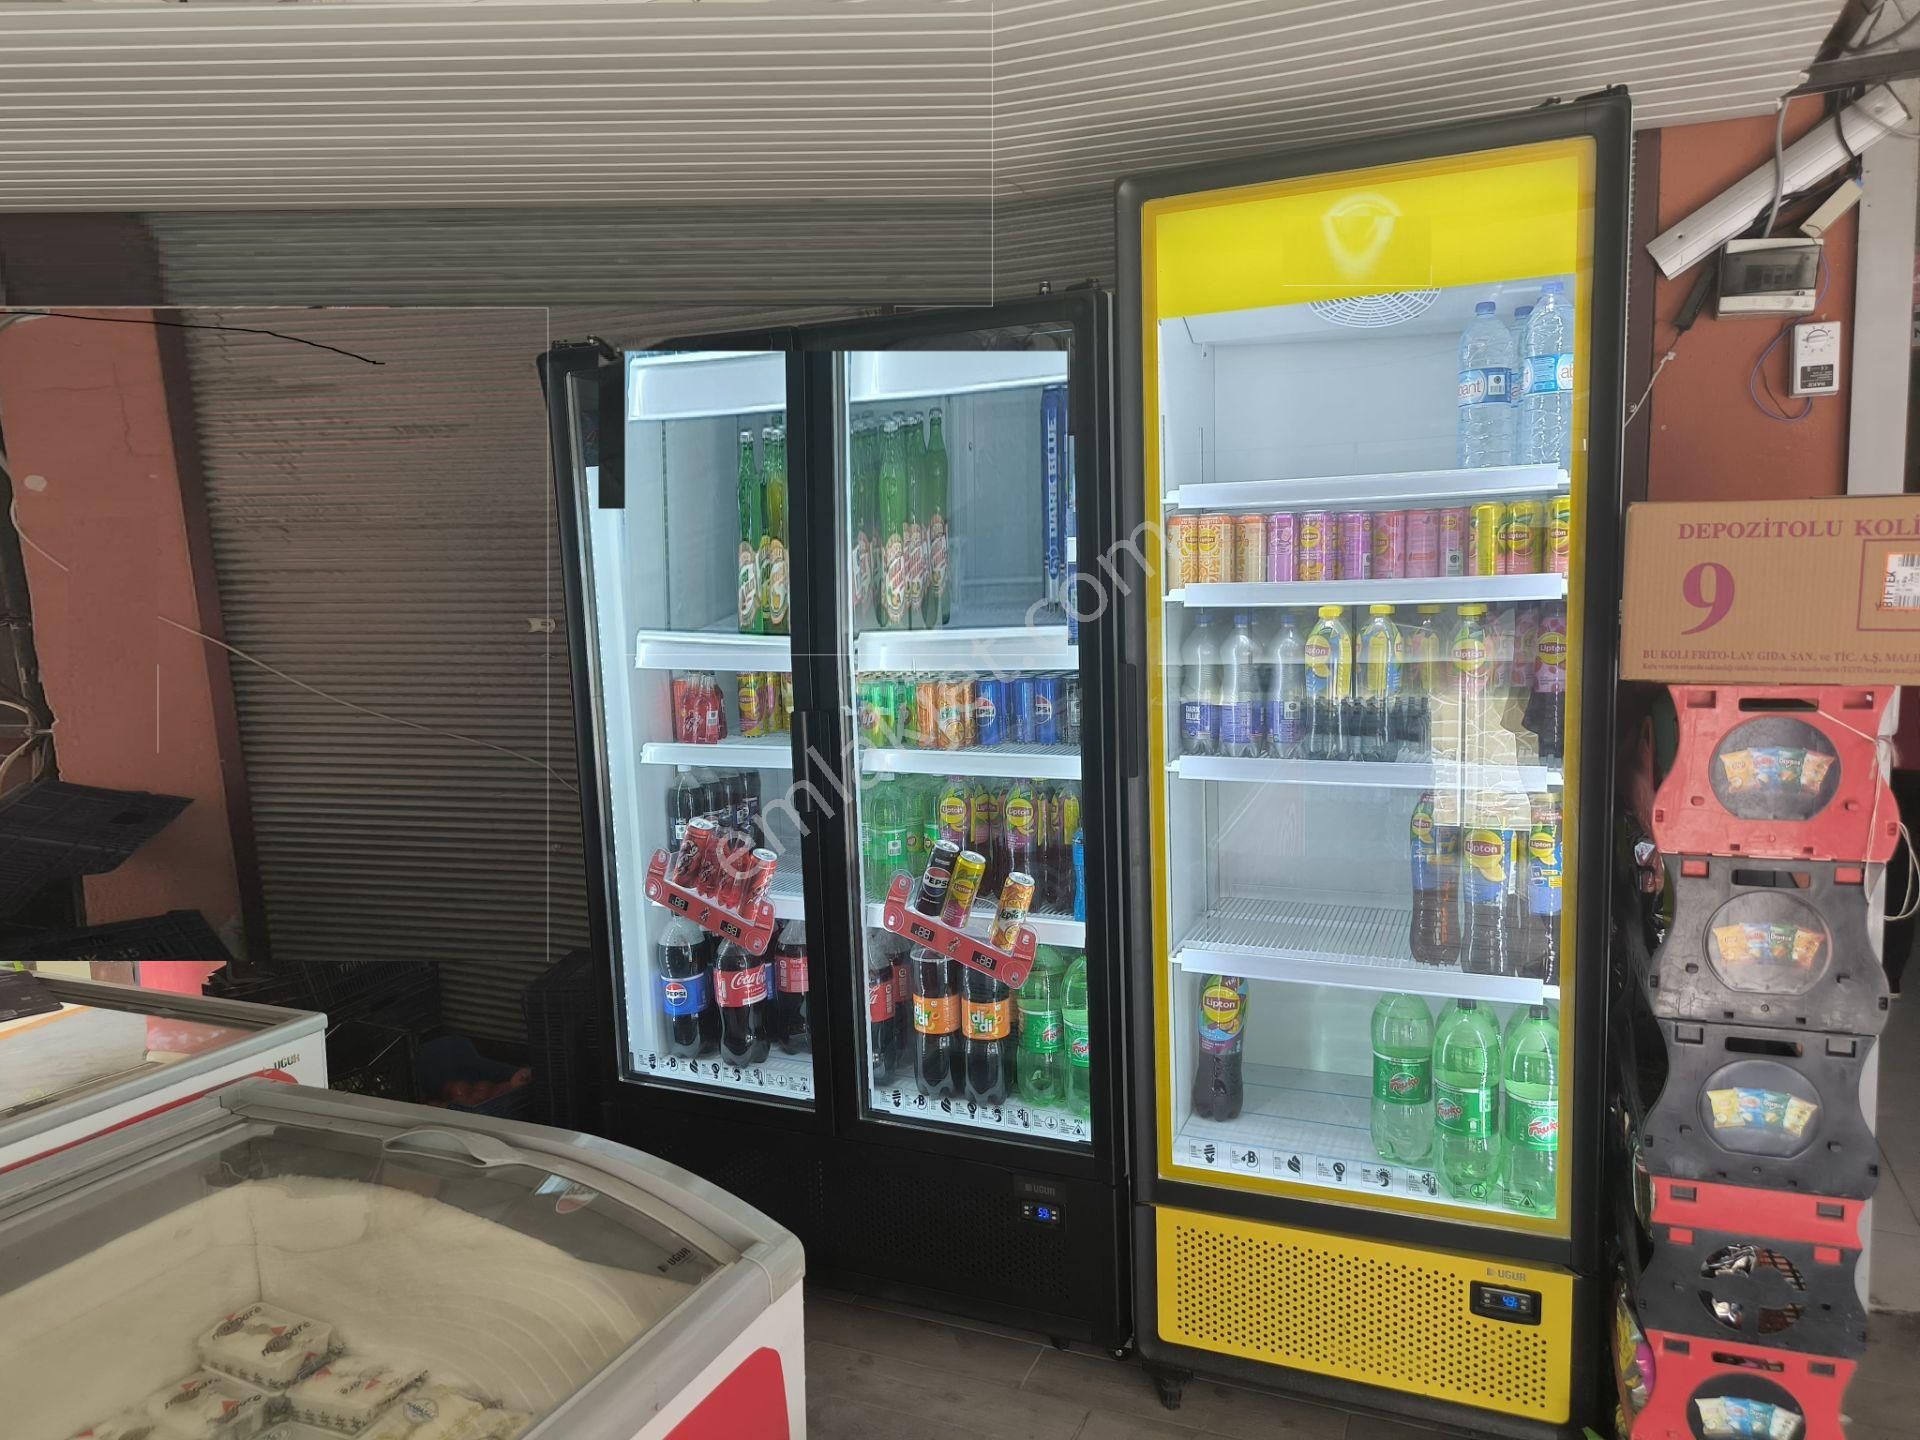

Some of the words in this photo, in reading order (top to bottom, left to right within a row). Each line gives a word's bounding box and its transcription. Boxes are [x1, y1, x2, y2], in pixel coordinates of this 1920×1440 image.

[1048, 417, 1057, 470] BLUE
[1679, 517, 1843, 540] DEPOZİTOLU
[1681, 562, 1735, 636] 9
[1540, 644, 1566, 653] Lipton
[1008, 807, 1029, 817] Lipton
[1466, 840, 1498, 856] Lipton
[1531, 841, 1552, 850] Lipton
[665, 990, 687, 998] PEPSI
[1205, 997, 1236, 1011] Lipton
[1389, 1077, 1420, 1092] Fruko
